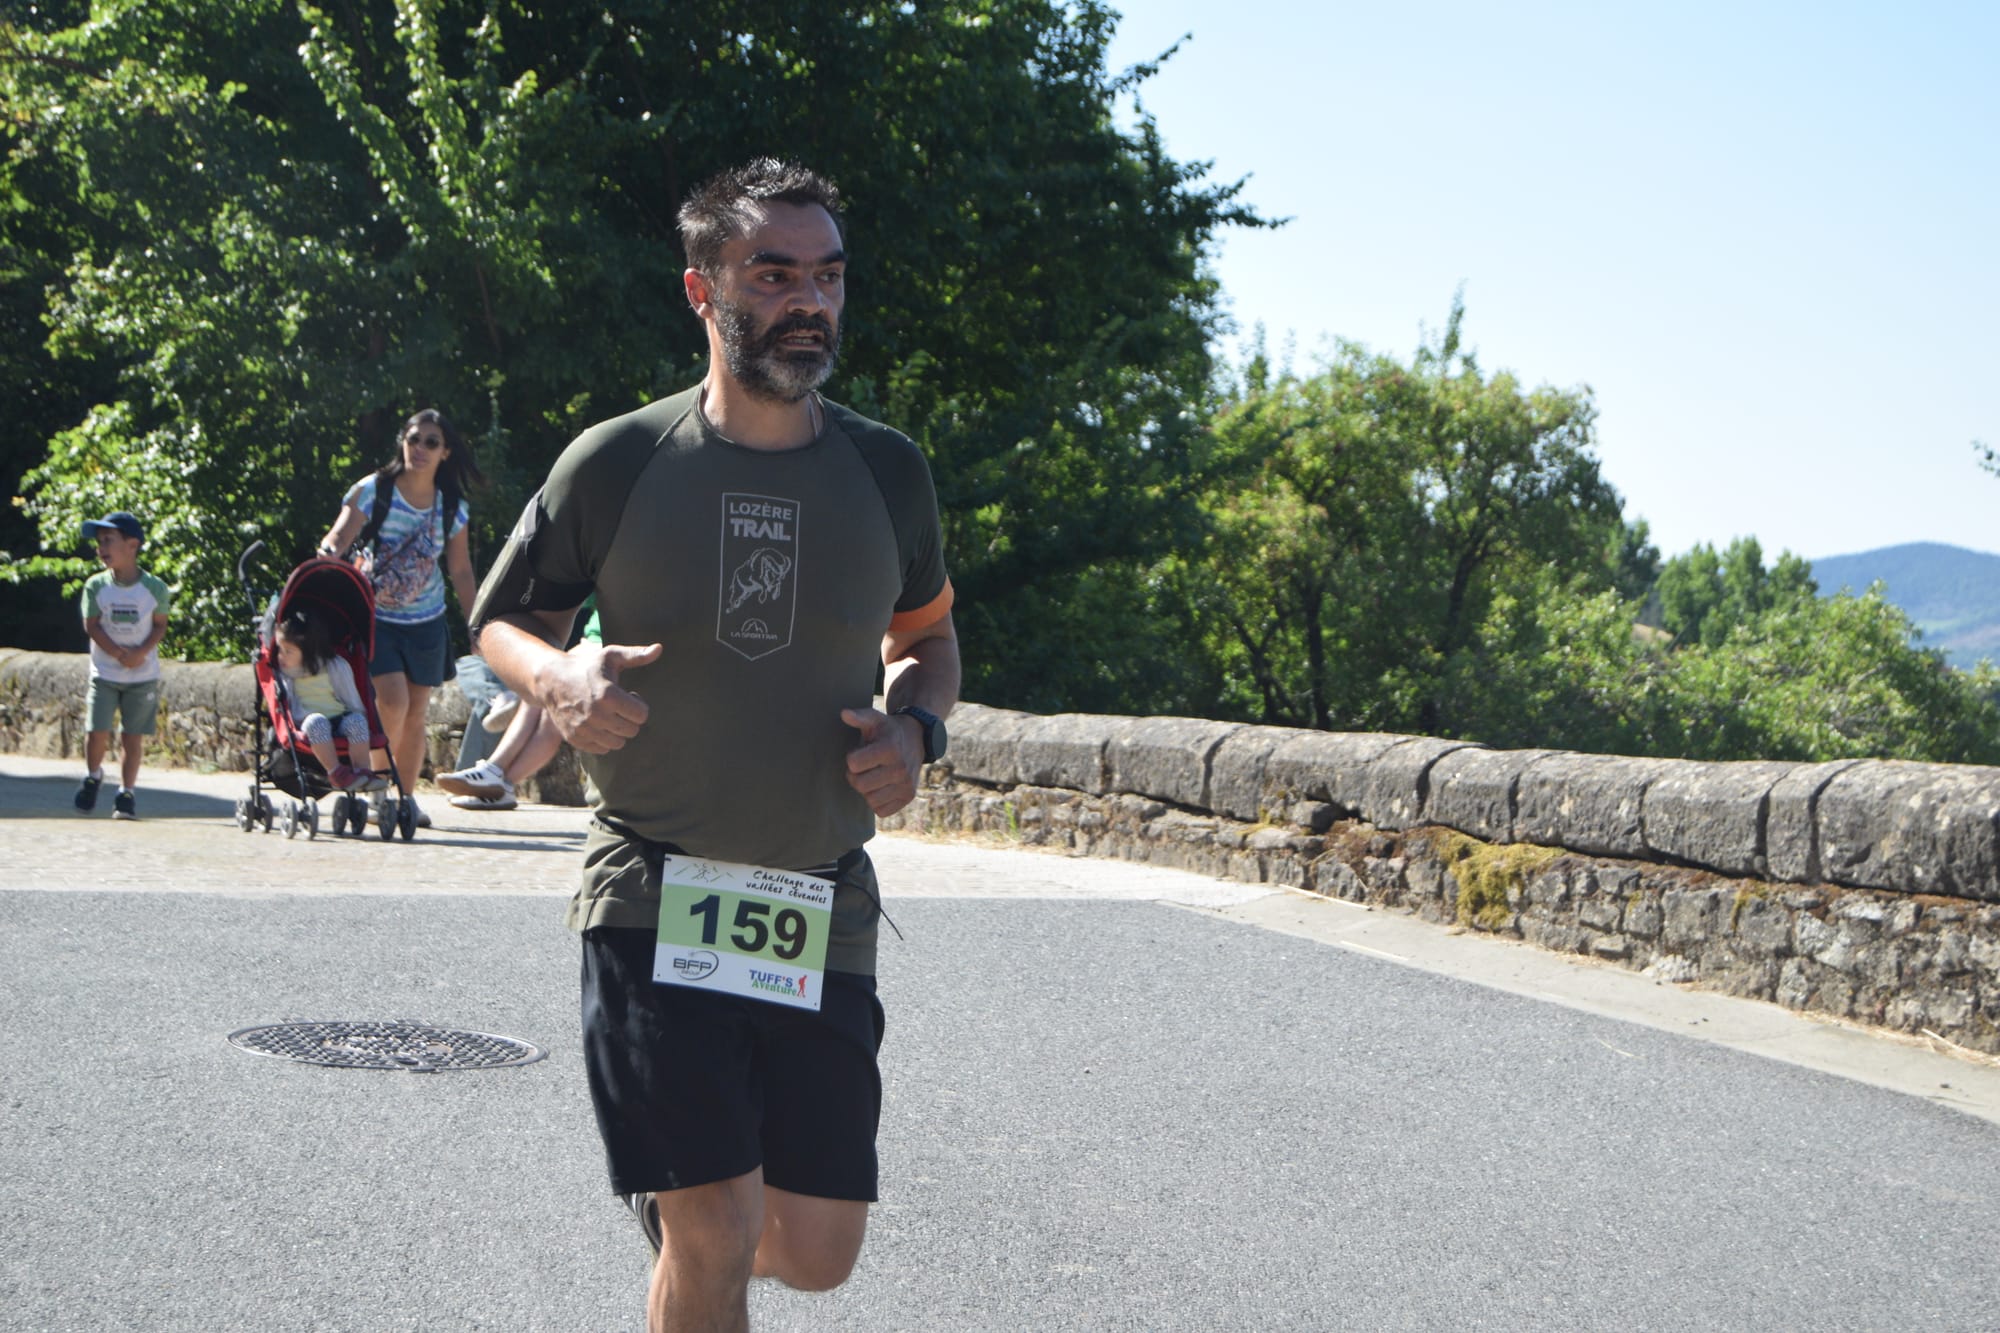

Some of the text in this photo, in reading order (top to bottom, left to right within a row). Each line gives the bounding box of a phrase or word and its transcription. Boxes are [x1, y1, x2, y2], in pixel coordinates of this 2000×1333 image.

[729, 502, 793, 521] LOZÈRE
[730, 517, 792, 541] TRAIL
[753, 870, 824, 892] Challenge des
[746, 881, 827, 904] vallées cévenoles
[689, 893, 808, 961] 159
[673, 957, 712, 972] BFP
[749, 969, 794, 988] TUFF'S
[751, 978, 798, 997] Aventure
